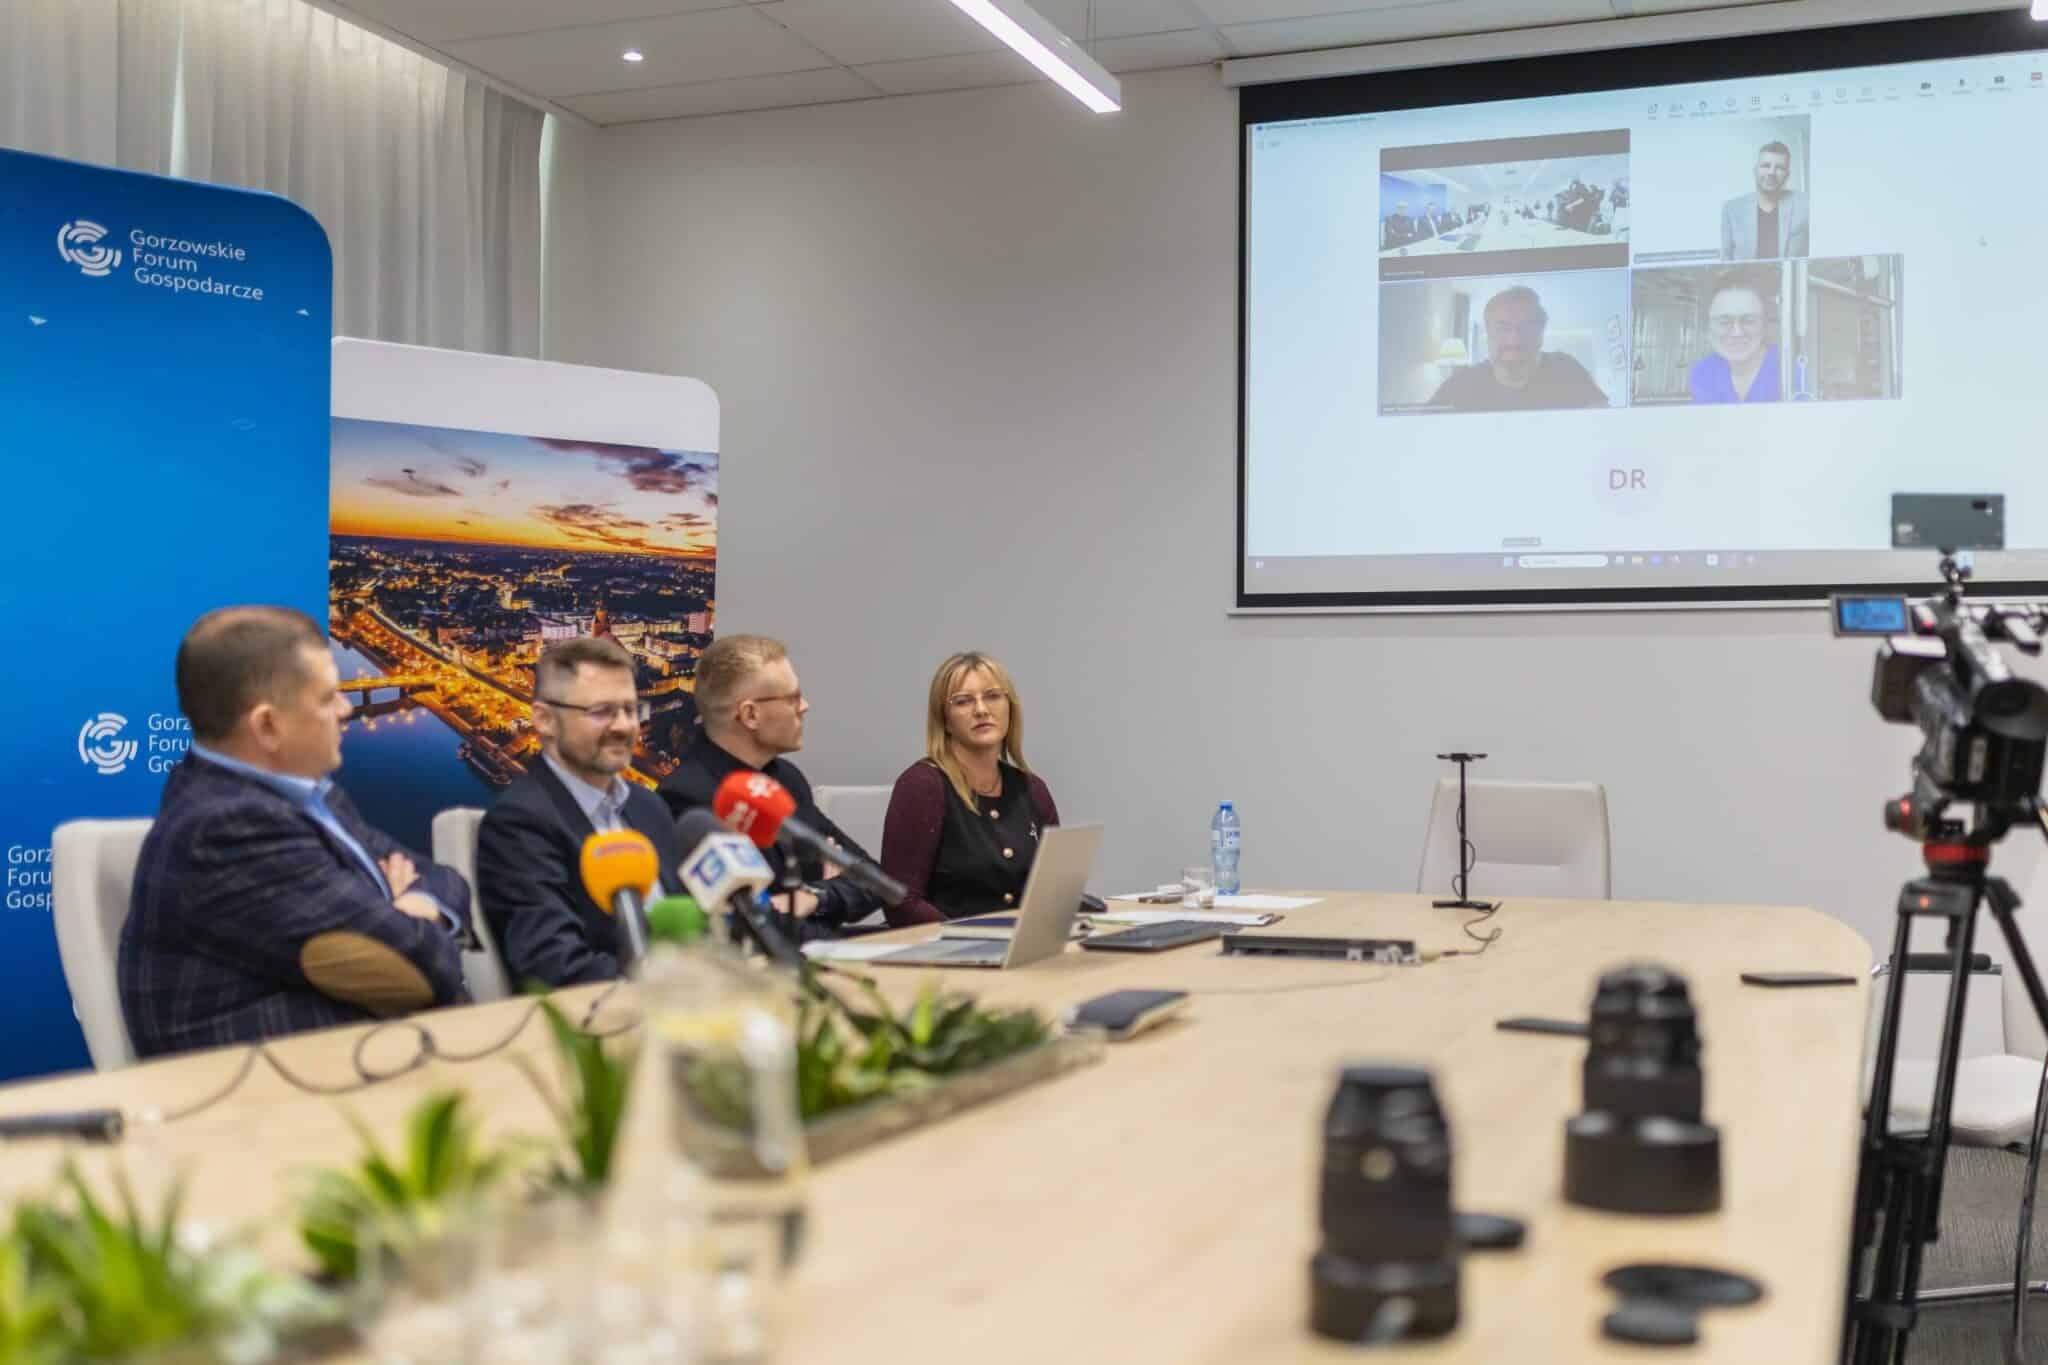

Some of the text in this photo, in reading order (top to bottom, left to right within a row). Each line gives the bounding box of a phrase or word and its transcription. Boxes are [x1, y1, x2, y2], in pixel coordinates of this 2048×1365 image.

[130, 229, 246, 261] Gorzowskie
[133, 247, 198, 272] Forum
[134, 267, 264, 300] Gospodarcze
[1609, 468, 1647, 489] DR
